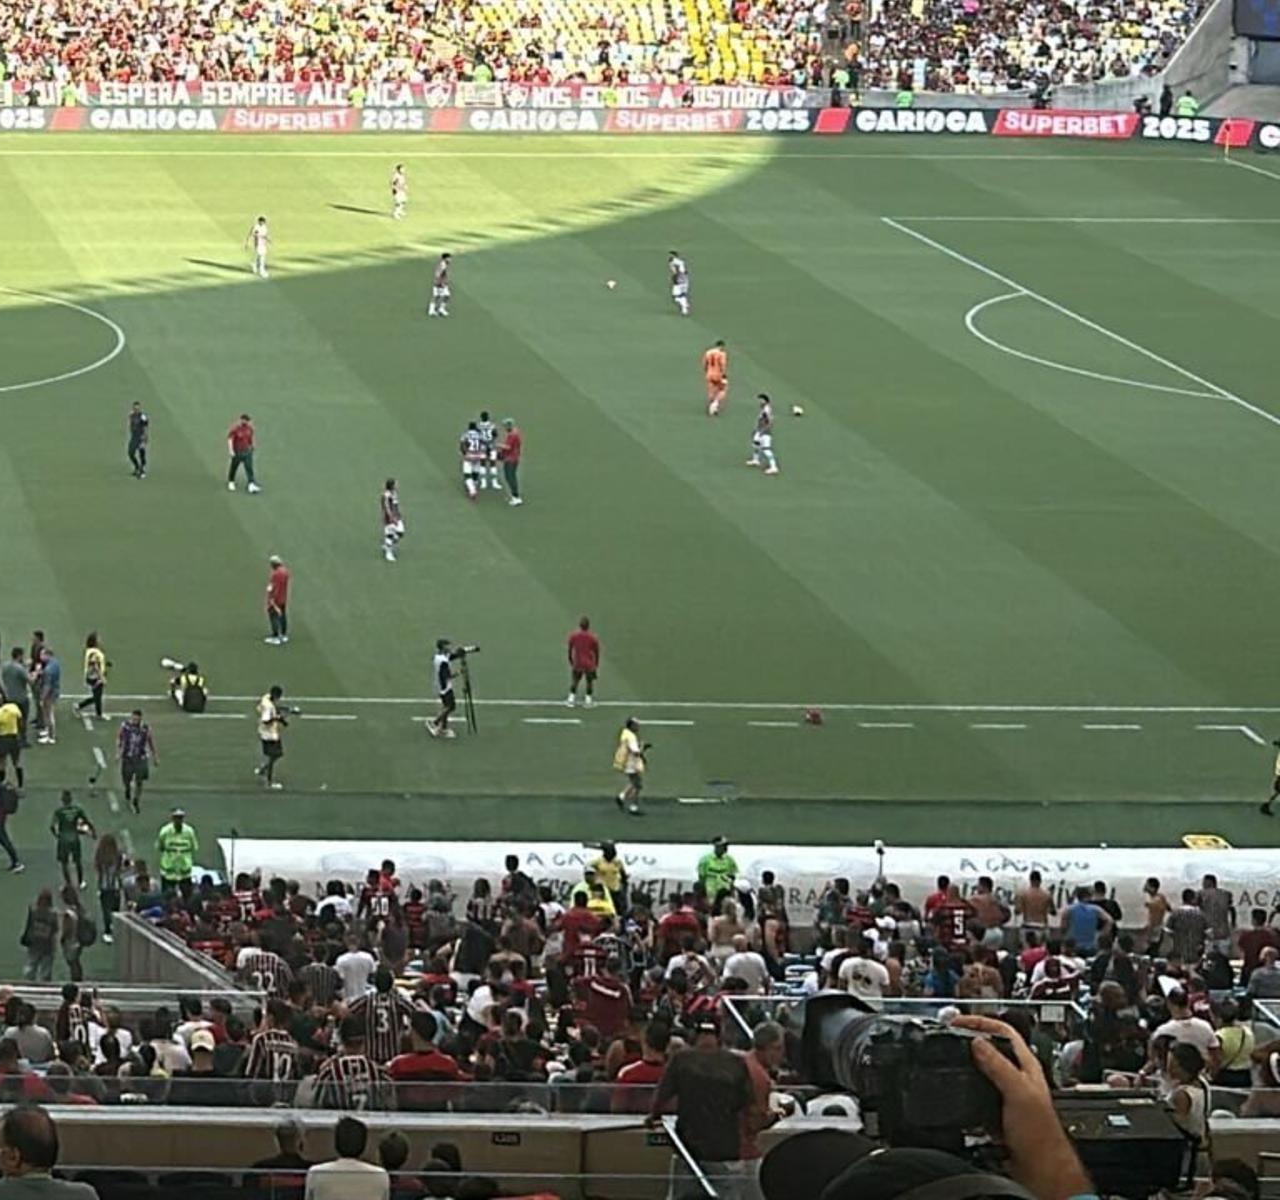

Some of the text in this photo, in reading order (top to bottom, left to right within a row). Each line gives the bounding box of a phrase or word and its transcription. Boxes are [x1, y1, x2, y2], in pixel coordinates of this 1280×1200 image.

[101, 81, 191, 106] ESPERA
[202, 81, 295, 106] SEMPRE
[89, 107, 423, 130] CARIOCA SUPERBET 2025
[469, 107, 810, 131] CARIOCA SUPERBET 2025
[856, 109, 1210, 142] CARIOCA SUPERBET 2025
[376, 1007, 389, 1033] 3
